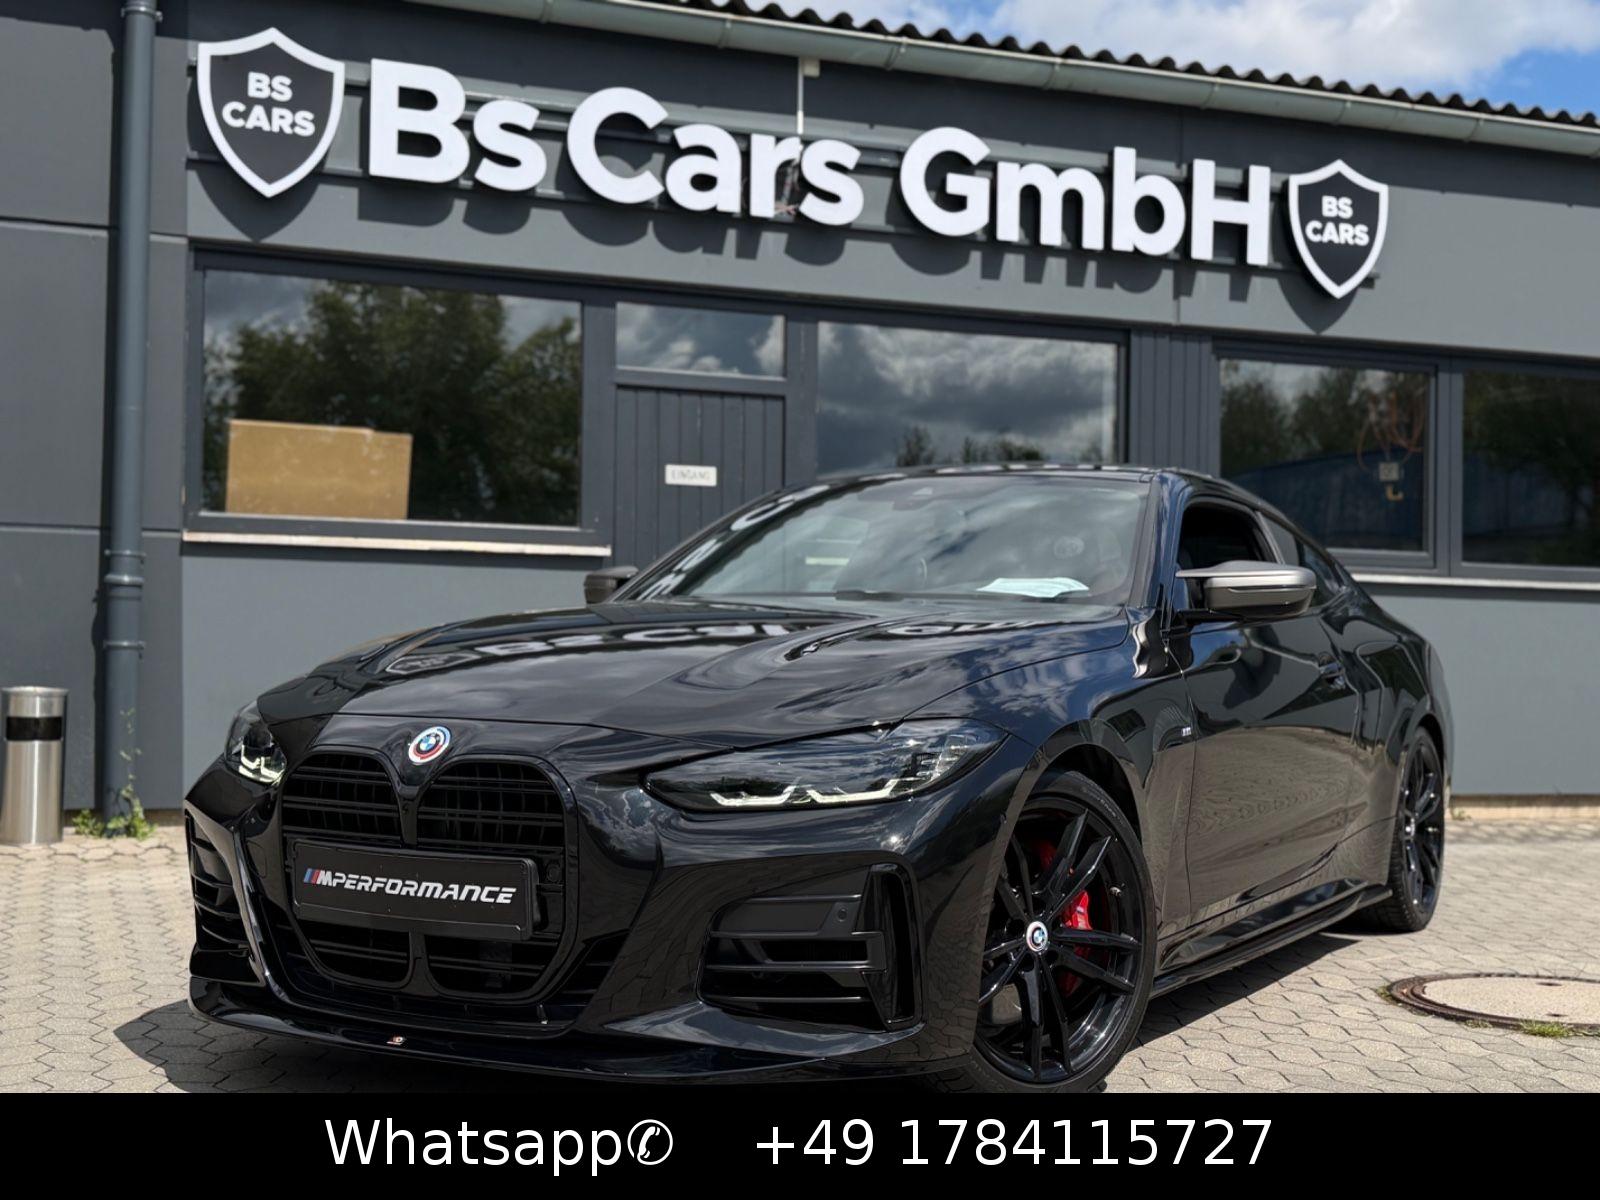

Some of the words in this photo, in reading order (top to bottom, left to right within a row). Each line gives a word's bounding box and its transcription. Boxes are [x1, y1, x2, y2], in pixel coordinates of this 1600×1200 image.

[247, 71, 293, 102] BS
[221, 101, 316, 137] CARS
[900, 127, 1271, 266] GmbH
[1321, 195, 1354, 219] BS
[1305, 220, 1370, 246] CARS
